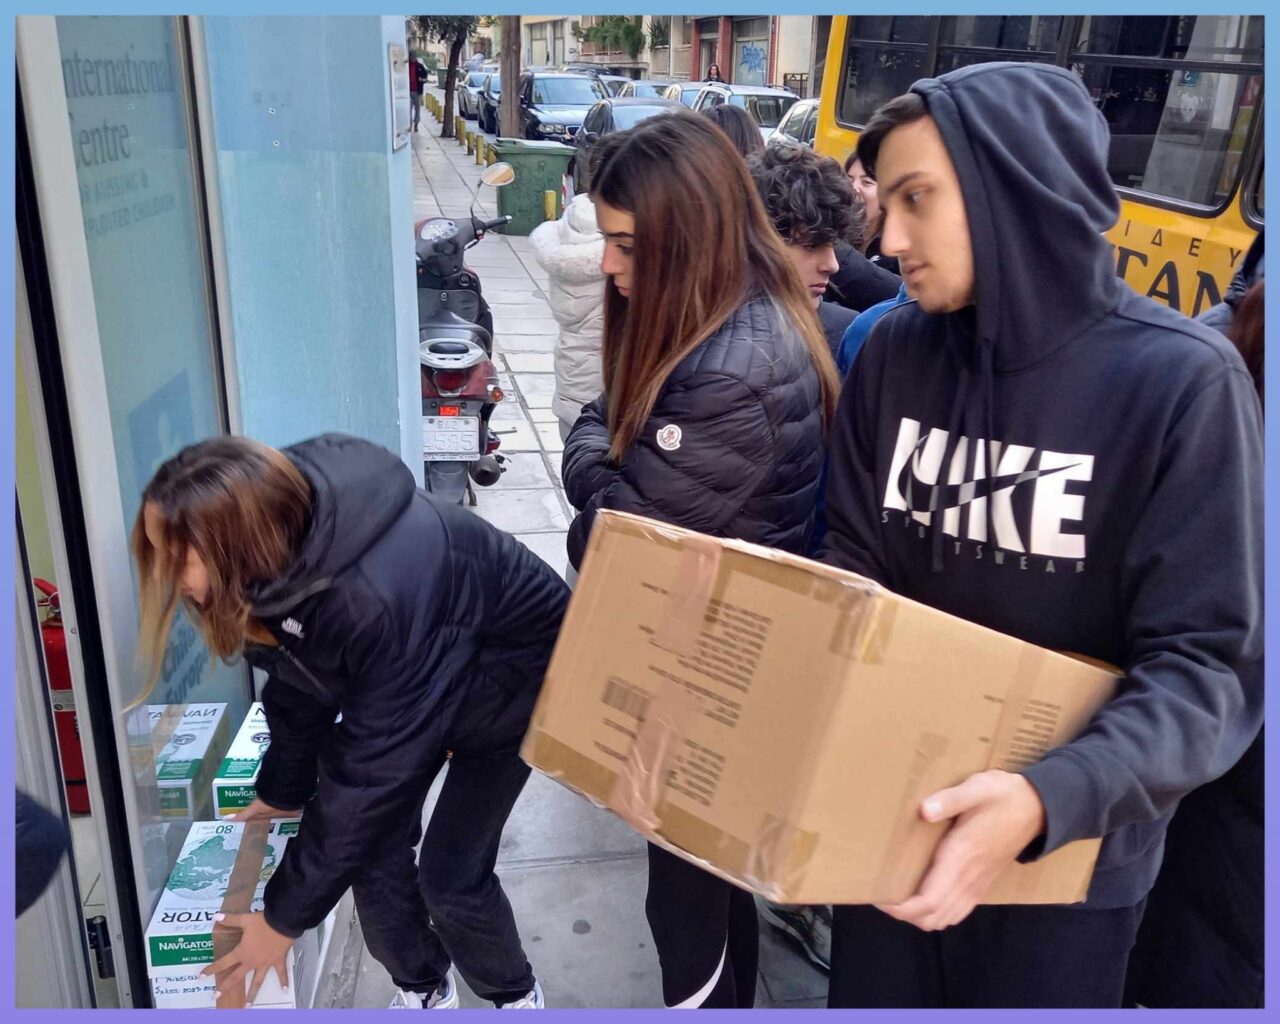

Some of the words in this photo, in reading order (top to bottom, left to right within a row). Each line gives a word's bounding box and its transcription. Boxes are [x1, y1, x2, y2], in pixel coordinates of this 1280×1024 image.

[62, 43, 174, 97] nternational
[75, 119, 130, 167] entre
[883, 417, 1095, 558] NIKE
[215, 825, 234, 834] 80
